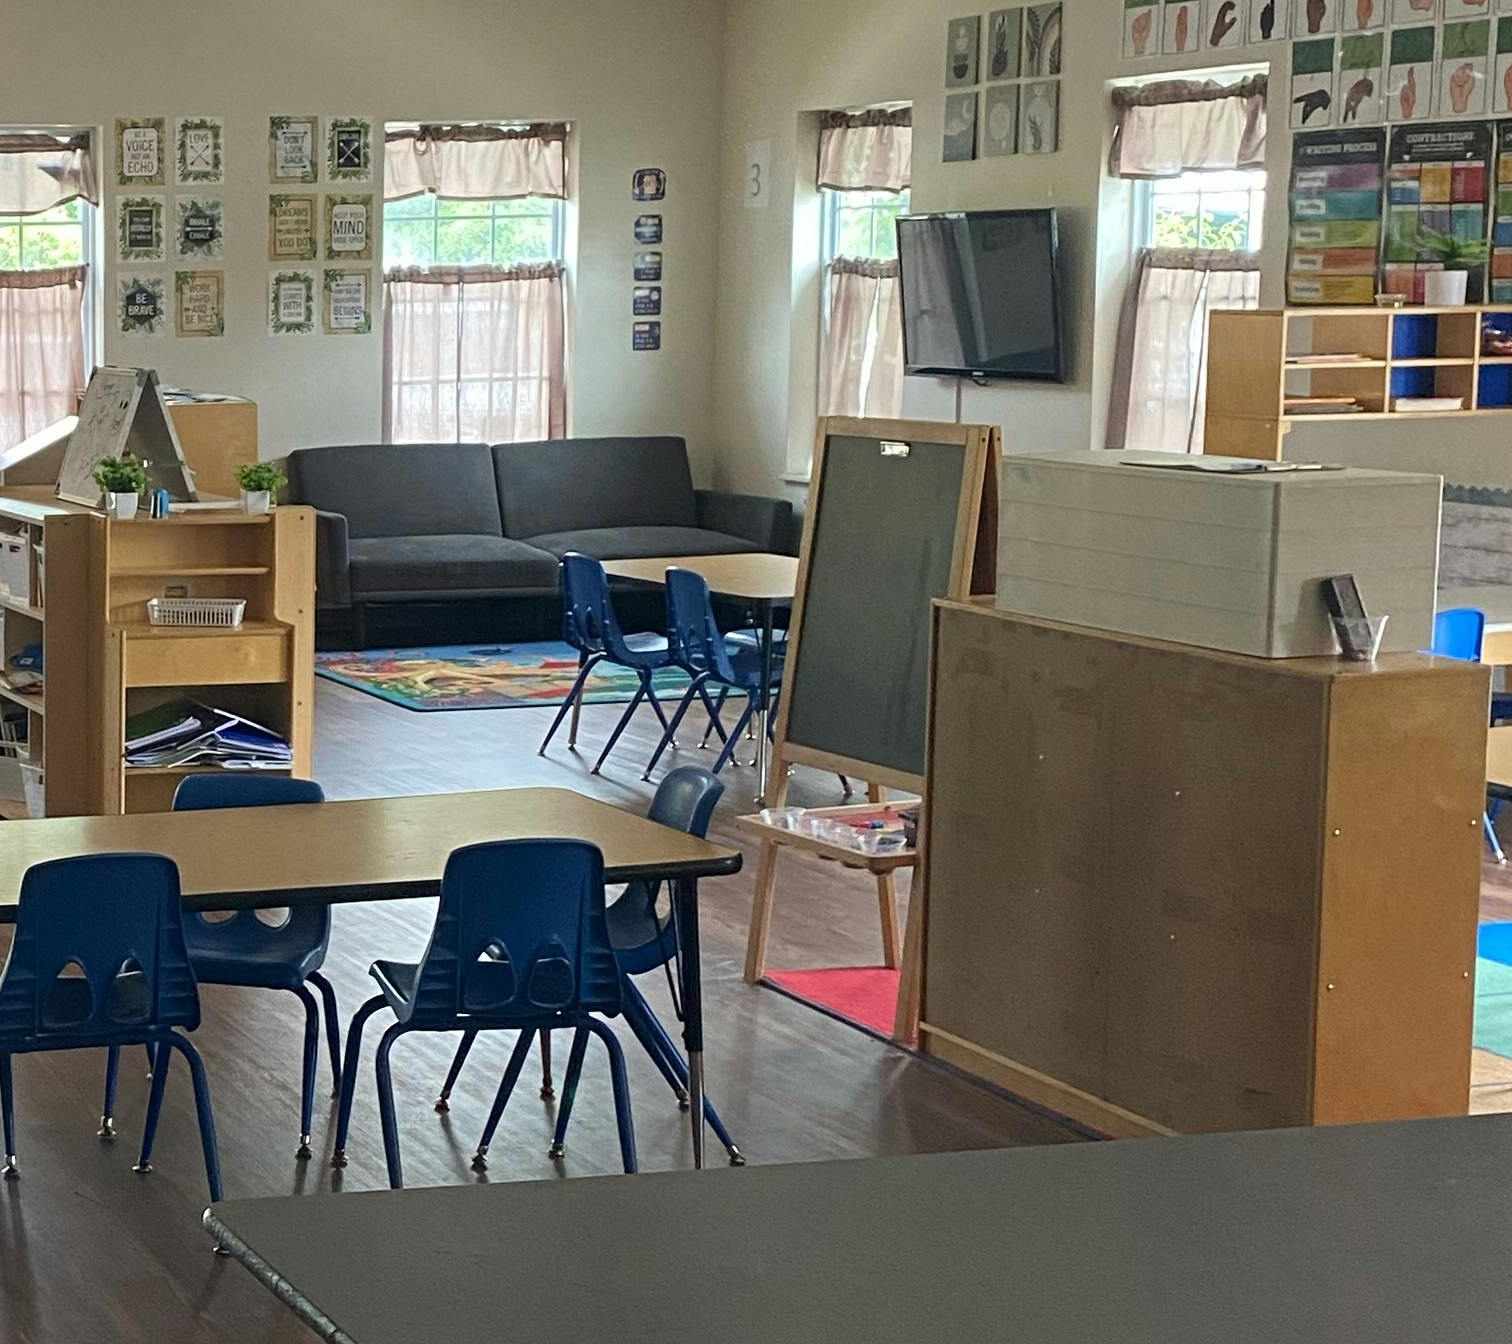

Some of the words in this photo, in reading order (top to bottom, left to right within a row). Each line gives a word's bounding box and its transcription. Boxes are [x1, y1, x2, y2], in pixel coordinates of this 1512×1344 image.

[189, 133, 209, 144] LOVE
[126, 140, 154, 152] VOICE
[284, 145, 304, 154] LOOK
[128, 161, 154, 173] ECHO
[333, 221, 365, 235] MIND
[278, 238, 295, 248] YOU
[135, 293, 147, 304] BE
[128, 305, 154, 315] BRAVE
[283, 301, 302, 310] WITH
